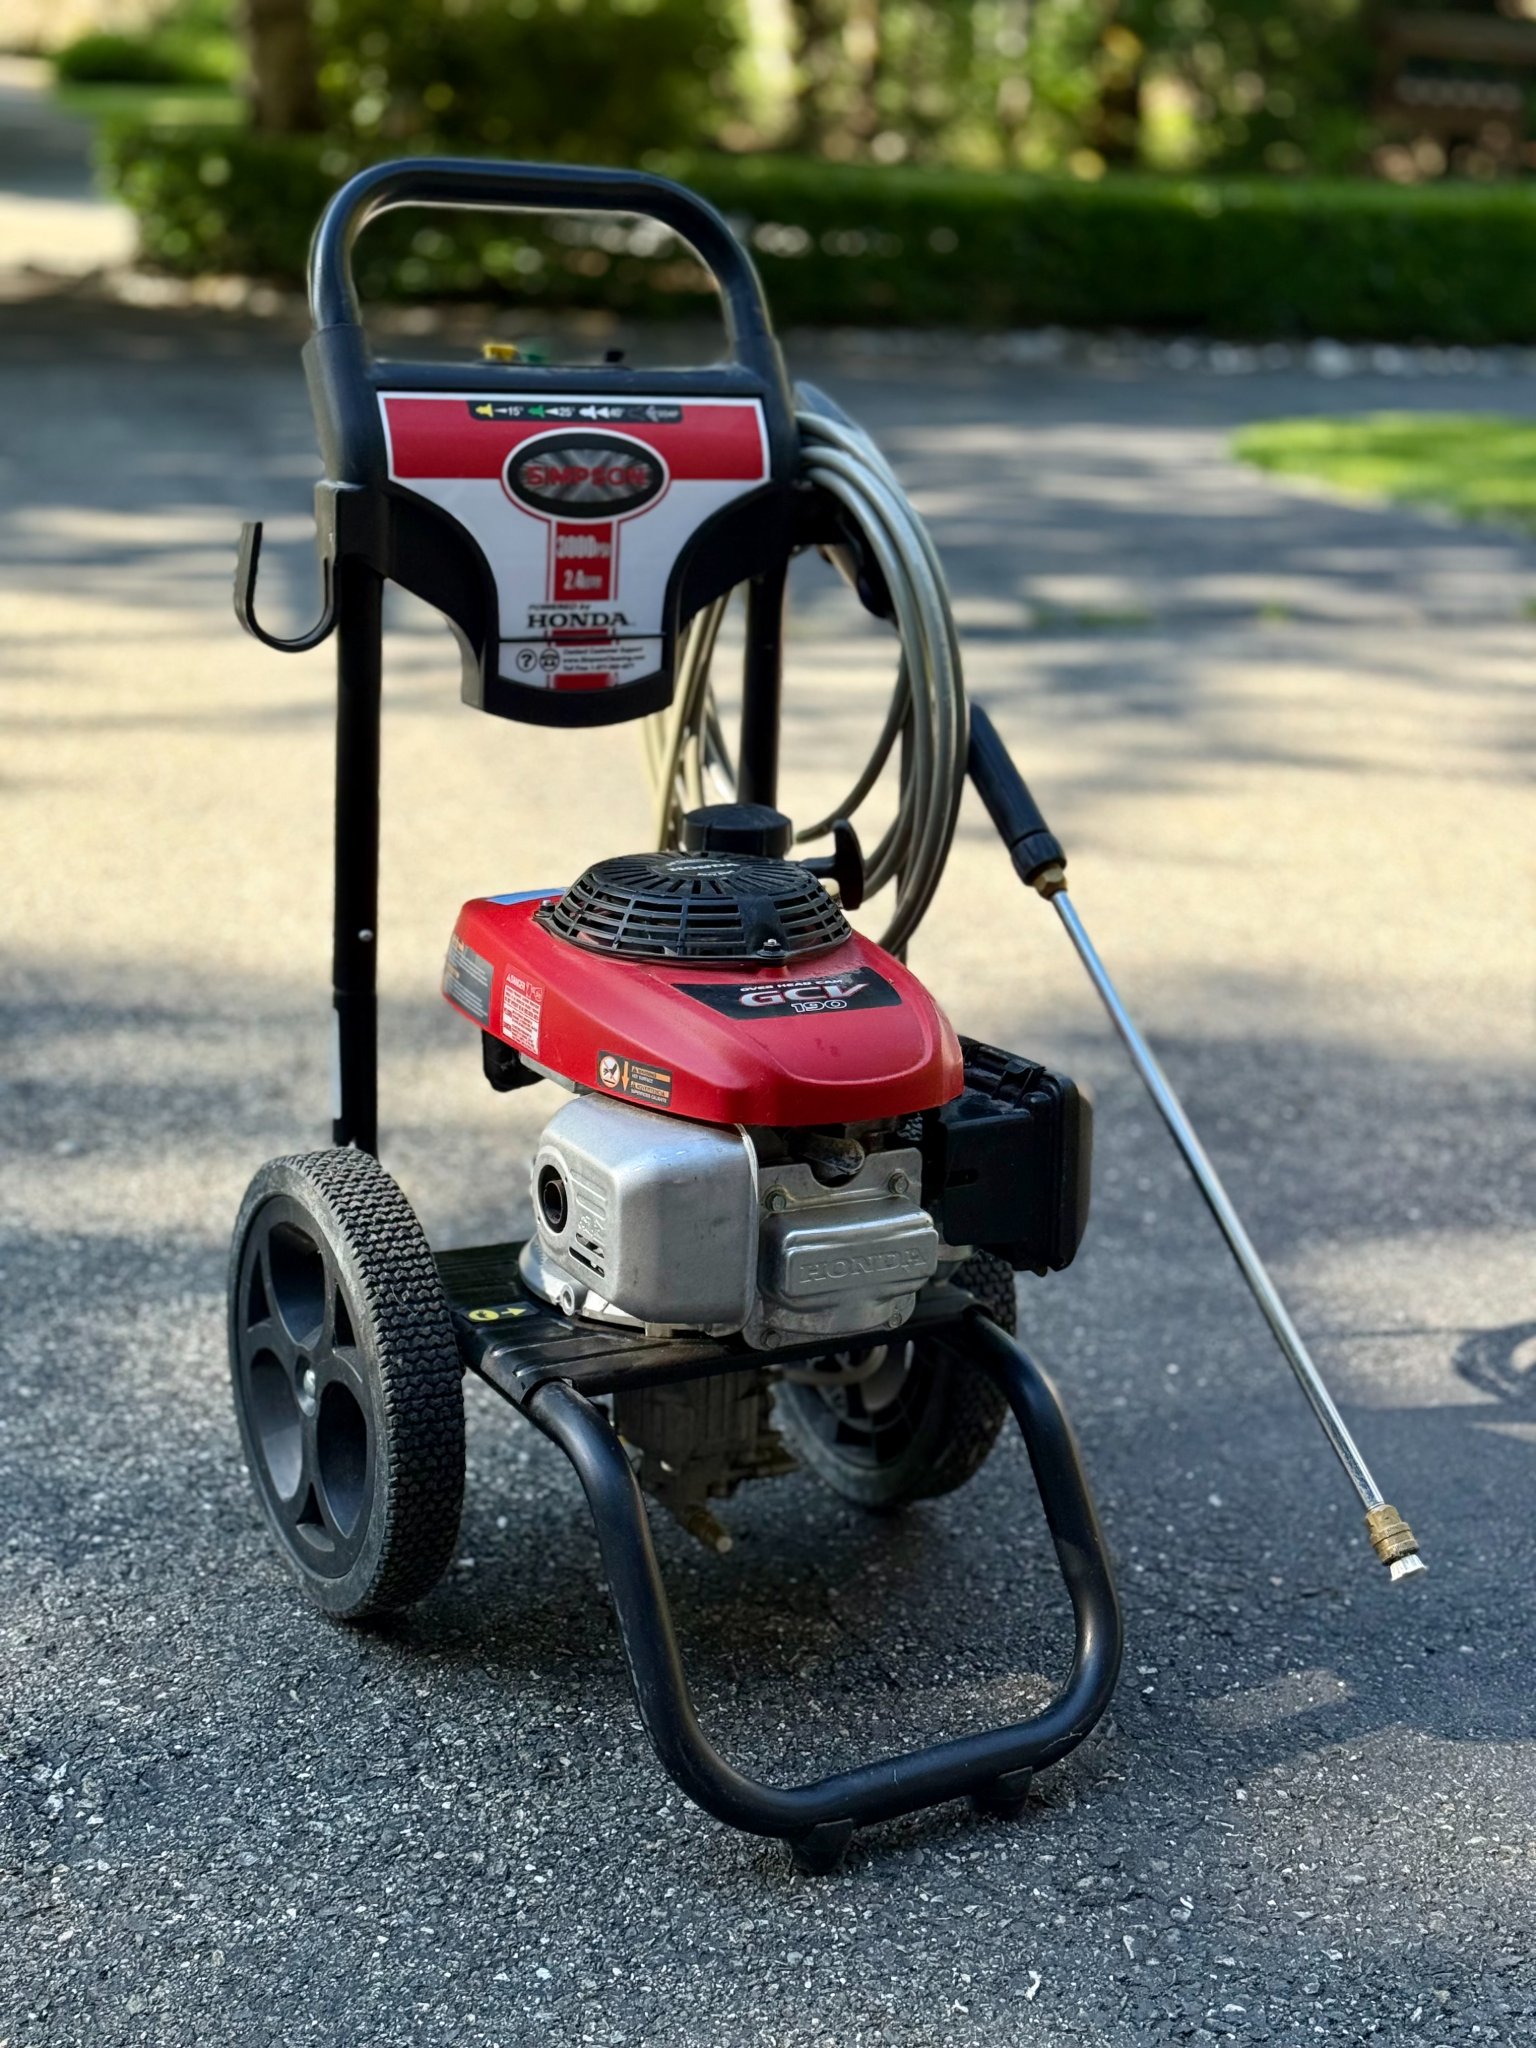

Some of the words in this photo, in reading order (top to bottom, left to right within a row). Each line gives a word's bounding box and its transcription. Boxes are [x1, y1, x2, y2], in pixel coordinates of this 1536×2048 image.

[526, 465, 646, 488] SIMPSON
[527, 612, 629, 629] HONDA
[739, 983, 869, 1007] GCV
[740, 984, 773, 992] OVER
[777, 981, 811, 989] HEAD
[791, 999, 847, 1013] 190
[799, 1248, 927, 1283] HONDA
